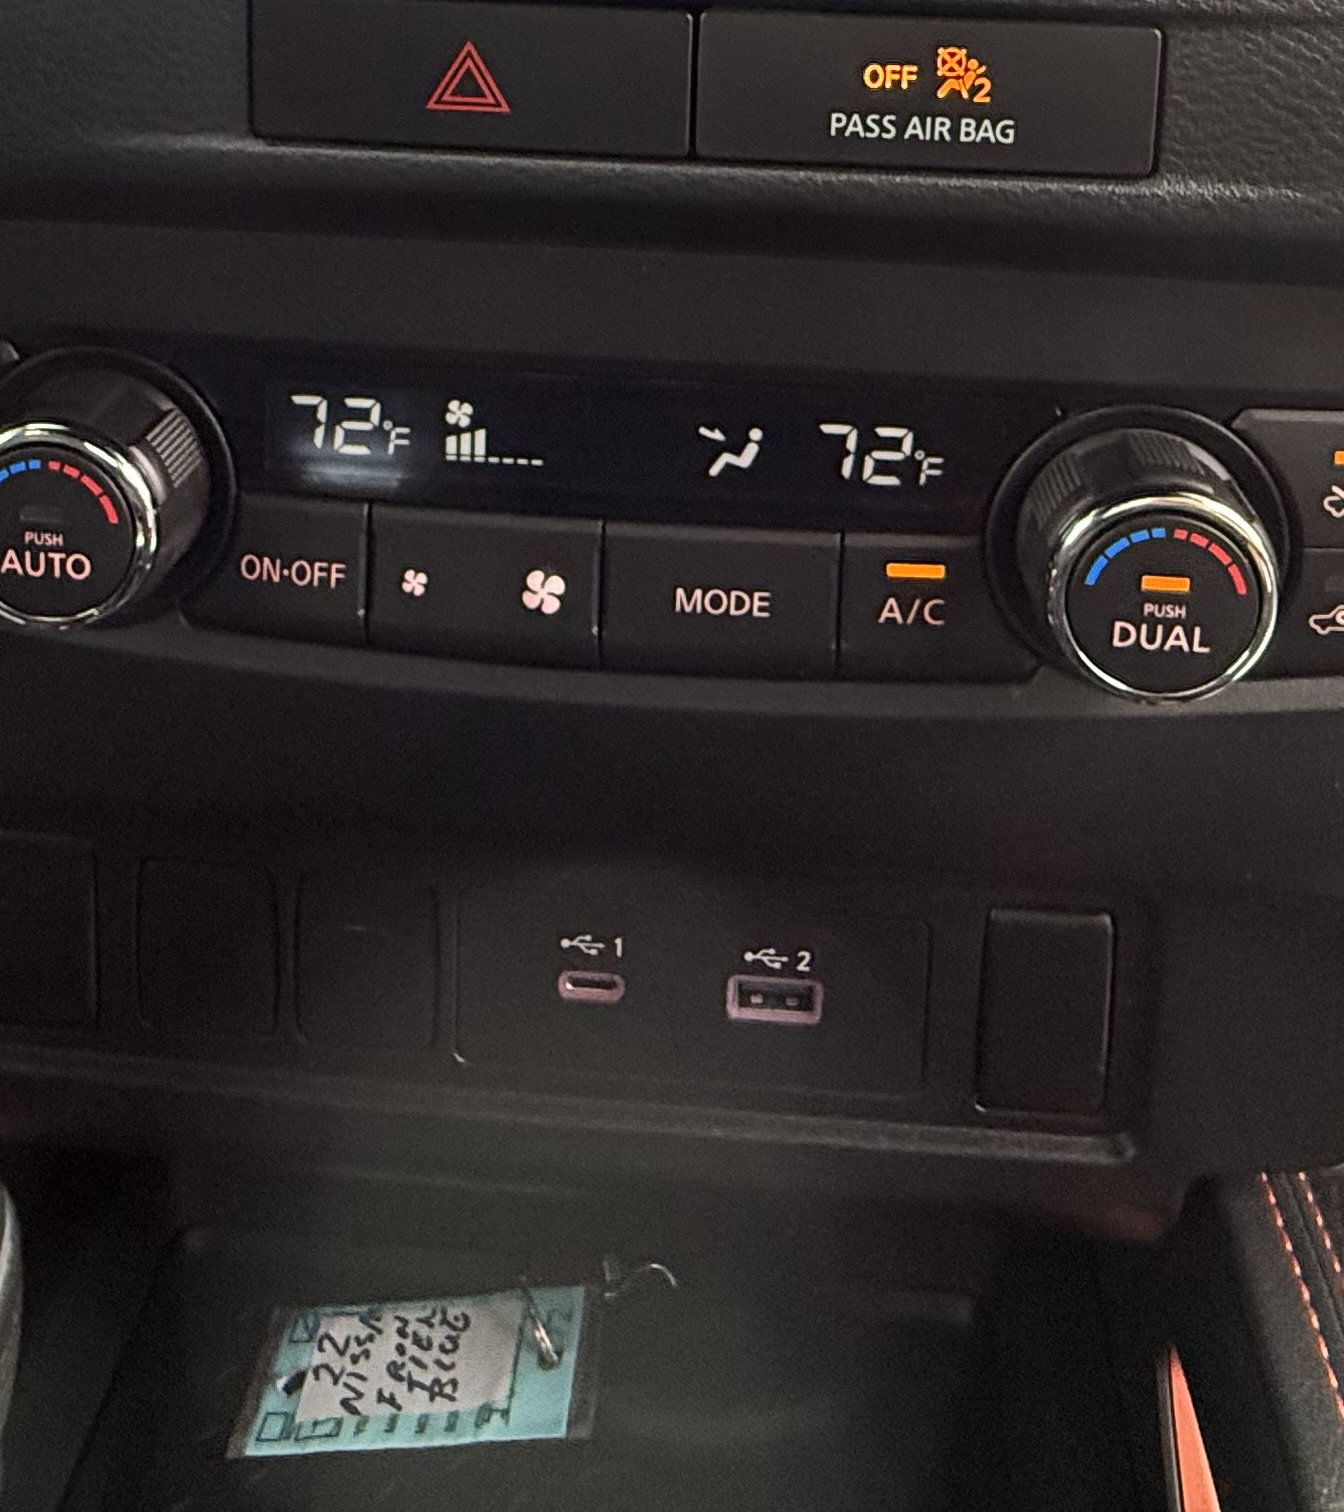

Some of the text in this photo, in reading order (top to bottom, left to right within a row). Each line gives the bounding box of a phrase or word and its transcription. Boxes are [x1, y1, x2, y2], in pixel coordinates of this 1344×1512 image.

[863, 62, 919, 90] OFF
[829, 112, 1016, 145] PASS AIR BAG
[24, 530, 65, 548] PUSH
[0, 547, 92, 581] AUTO
[674, 586, 772, 618] MODE
[878, 596, 946, 626] A/C
[1143, 602, 1187, 620] PUSH
[1111, 620, 1212, 655] DUAL
[613, 937, 624, 958] 1
[796, 950, 812, 972] 2
